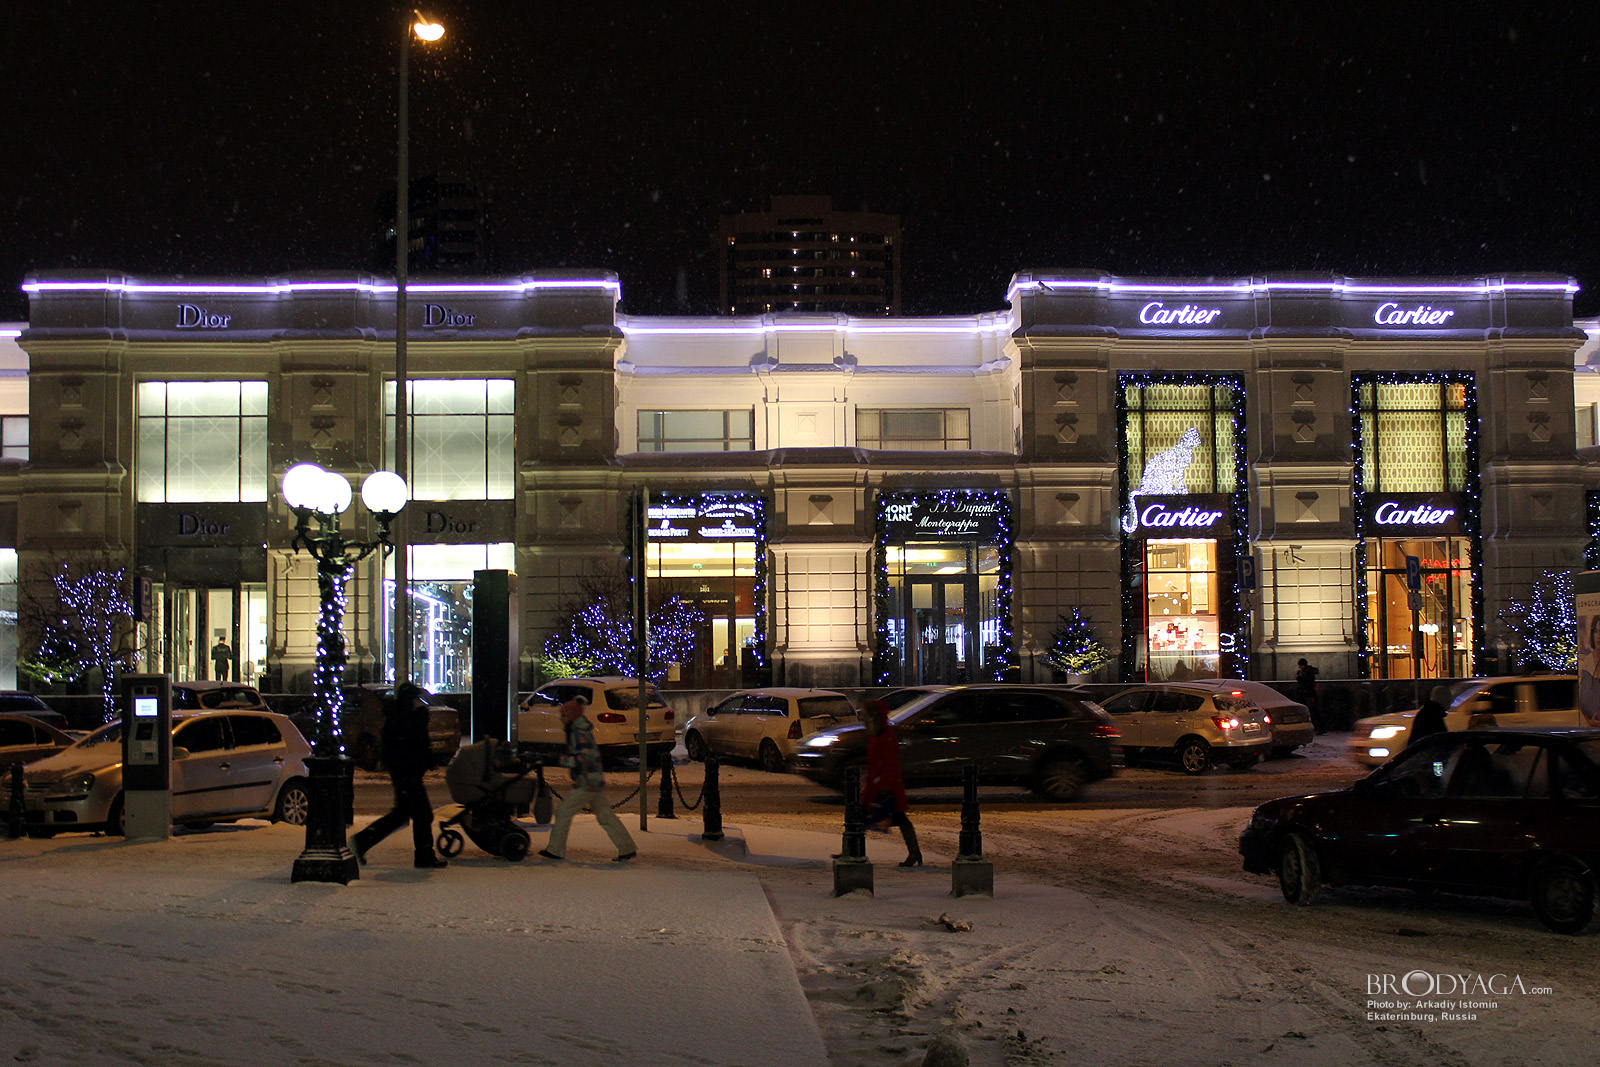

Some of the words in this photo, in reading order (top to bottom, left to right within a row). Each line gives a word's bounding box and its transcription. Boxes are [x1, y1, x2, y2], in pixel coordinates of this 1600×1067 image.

[176, 304, 231, 328] Dior
[422, 303, 476, 327] Dior
[1139, 301, 1221, 325] Cartier
[1374, 302, 1455, 325] Cartier
[953, 501, 999, 517] Dupont
[1140, 503, 1223, 527] Cartier
[1374, 502, 1455, 525] Cartier
[176, 513, 230, 536] Dior
[424, 511, 477, 534] Dior
[915, 515, 979, 532] Montegrappa
